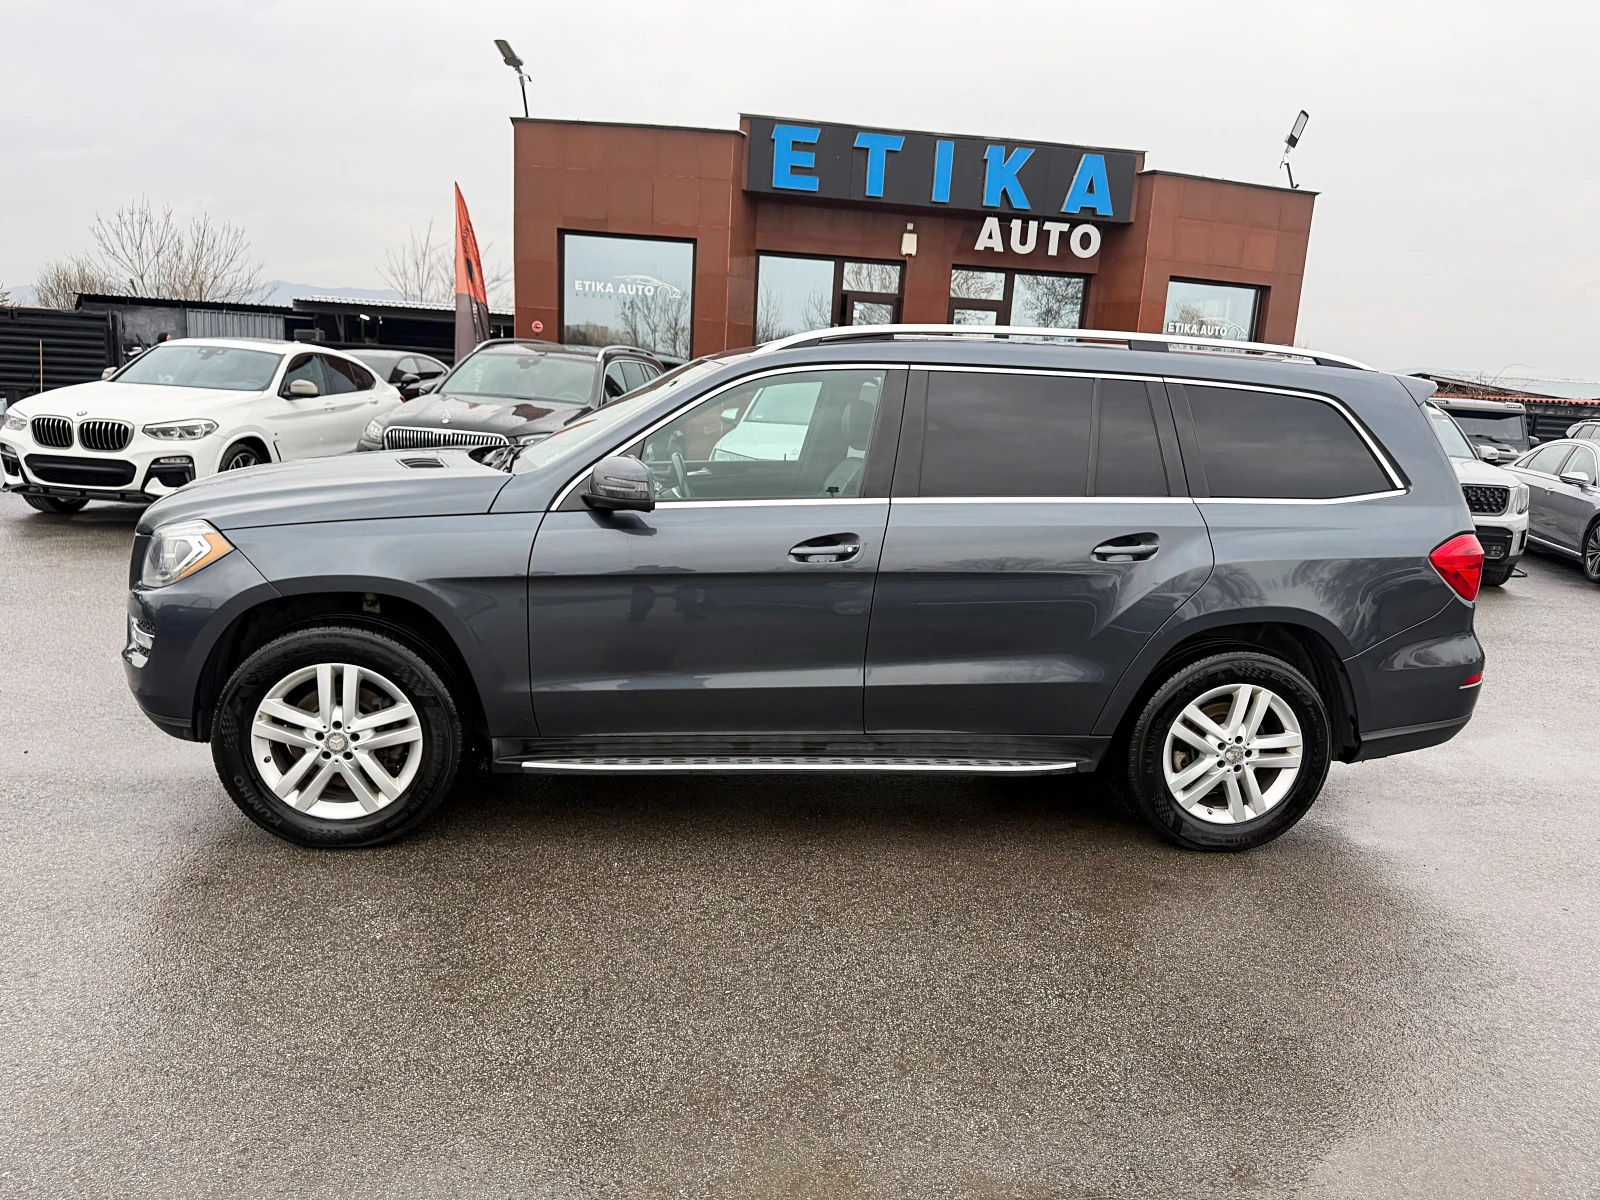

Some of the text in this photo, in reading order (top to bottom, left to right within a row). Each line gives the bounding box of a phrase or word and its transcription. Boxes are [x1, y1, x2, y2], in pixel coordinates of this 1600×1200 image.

[771, 124, 1114, 217] ETIKA
[974, 216, 1101, 259] AUTO
[574, 280, 655, 296] ETIKA AUTO
[1167, 322, 1227, 336] ETIKA AUTO
[1145, 717, 1164, 774] KUMHO
[233, 775, 282, 826] KUMHO
